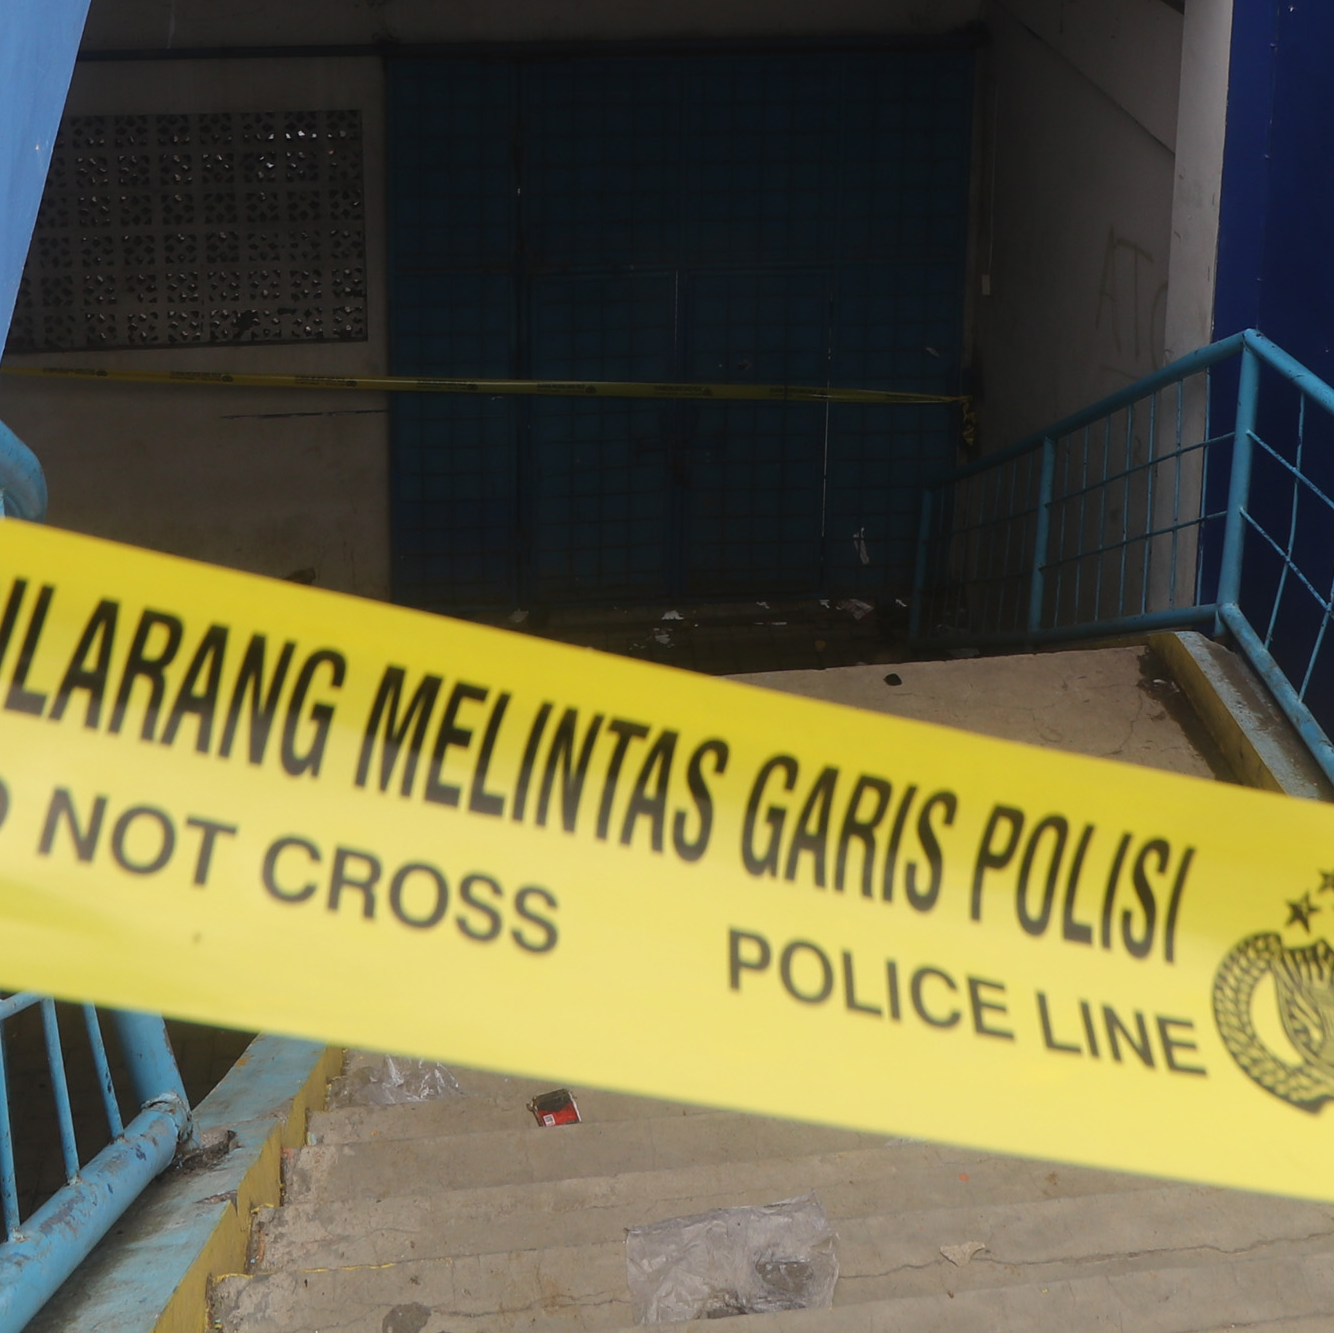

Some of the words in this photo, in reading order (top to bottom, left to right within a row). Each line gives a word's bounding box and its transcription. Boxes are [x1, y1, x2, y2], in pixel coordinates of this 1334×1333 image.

[36, 786, 238, 888] NOT
[260, 834, 560, 955] CROSS
[728, 927, 1016, 1041] POLICE
[1035, 990, 1208, 1077] LINE
[354, 665, 729, 863] MELINTAS
[741, 753, 958, 913] GARIS
[969, 803, 1197, 964] POLISI
